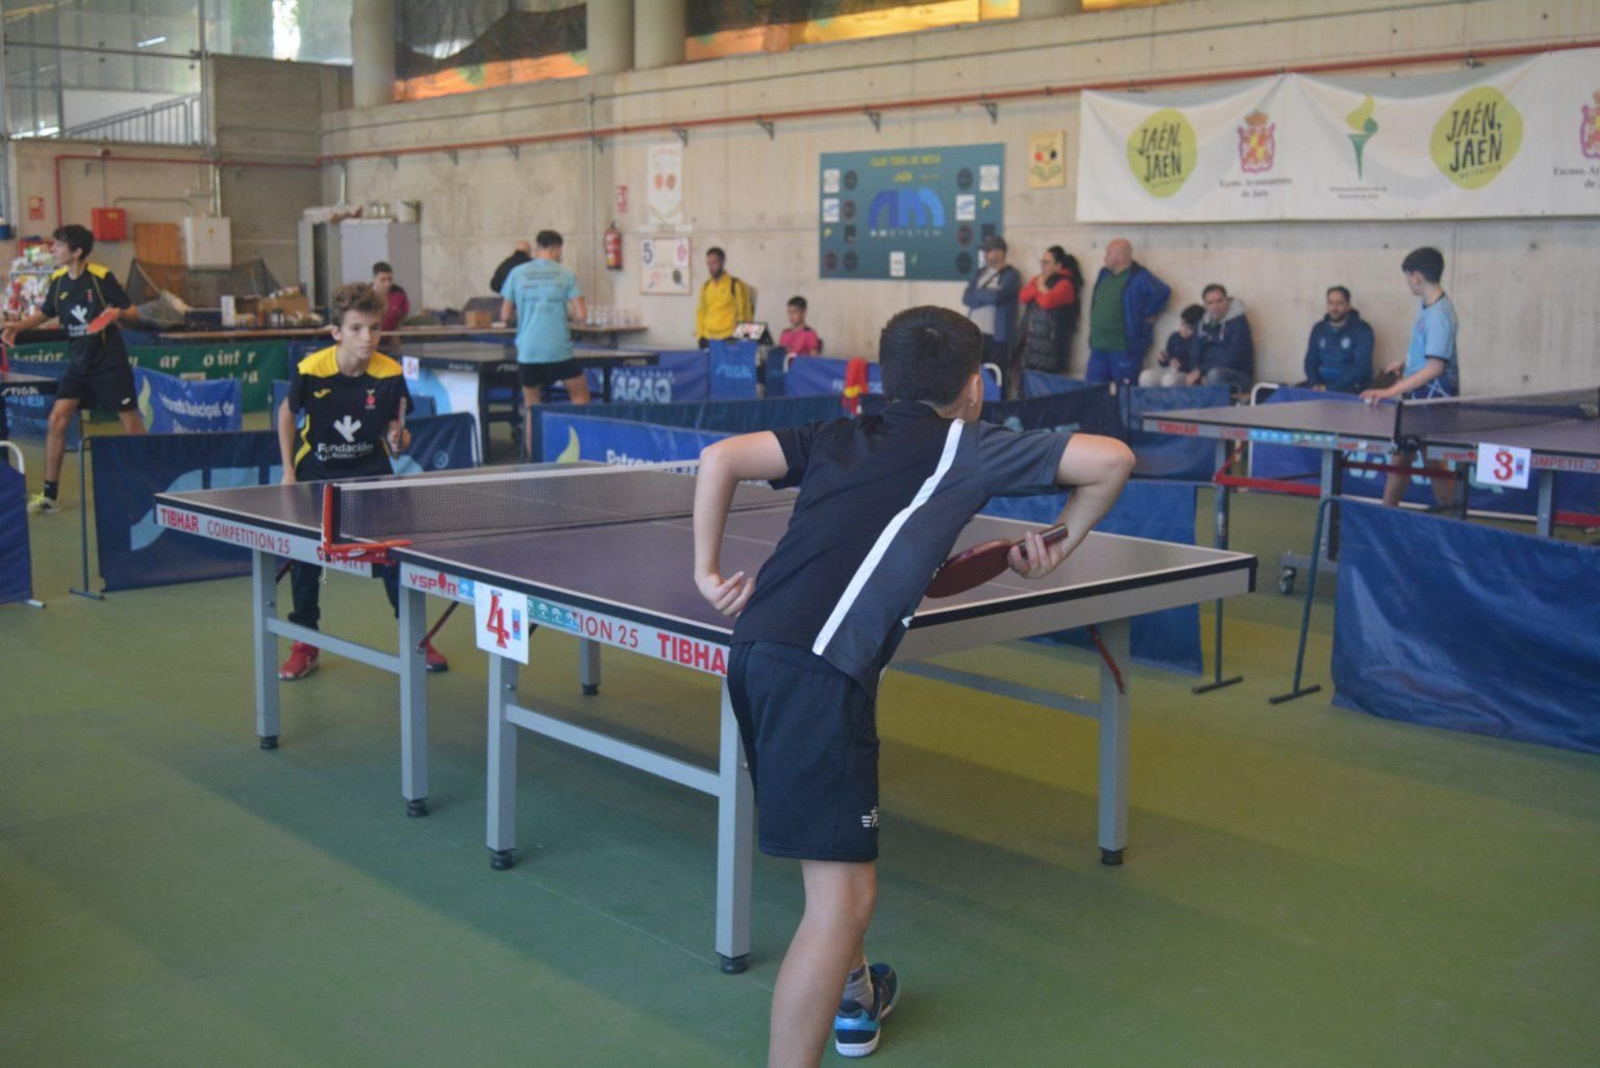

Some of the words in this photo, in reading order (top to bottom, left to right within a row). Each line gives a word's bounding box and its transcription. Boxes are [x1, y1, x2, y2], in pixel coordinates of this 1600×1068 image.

[1494, 450, 1514, 481] 3
[161, 508, 200, 532] TIBHAR
[206, 519, 276, 551] COMPETITION
[277, 536, 291, 555] 25
[409, 572, 458, 596] VSPOR
[618, 624, 639, 648] 25
[657, 632, 727, 675] TIBHA
[486, 594, 511, 650] 4
